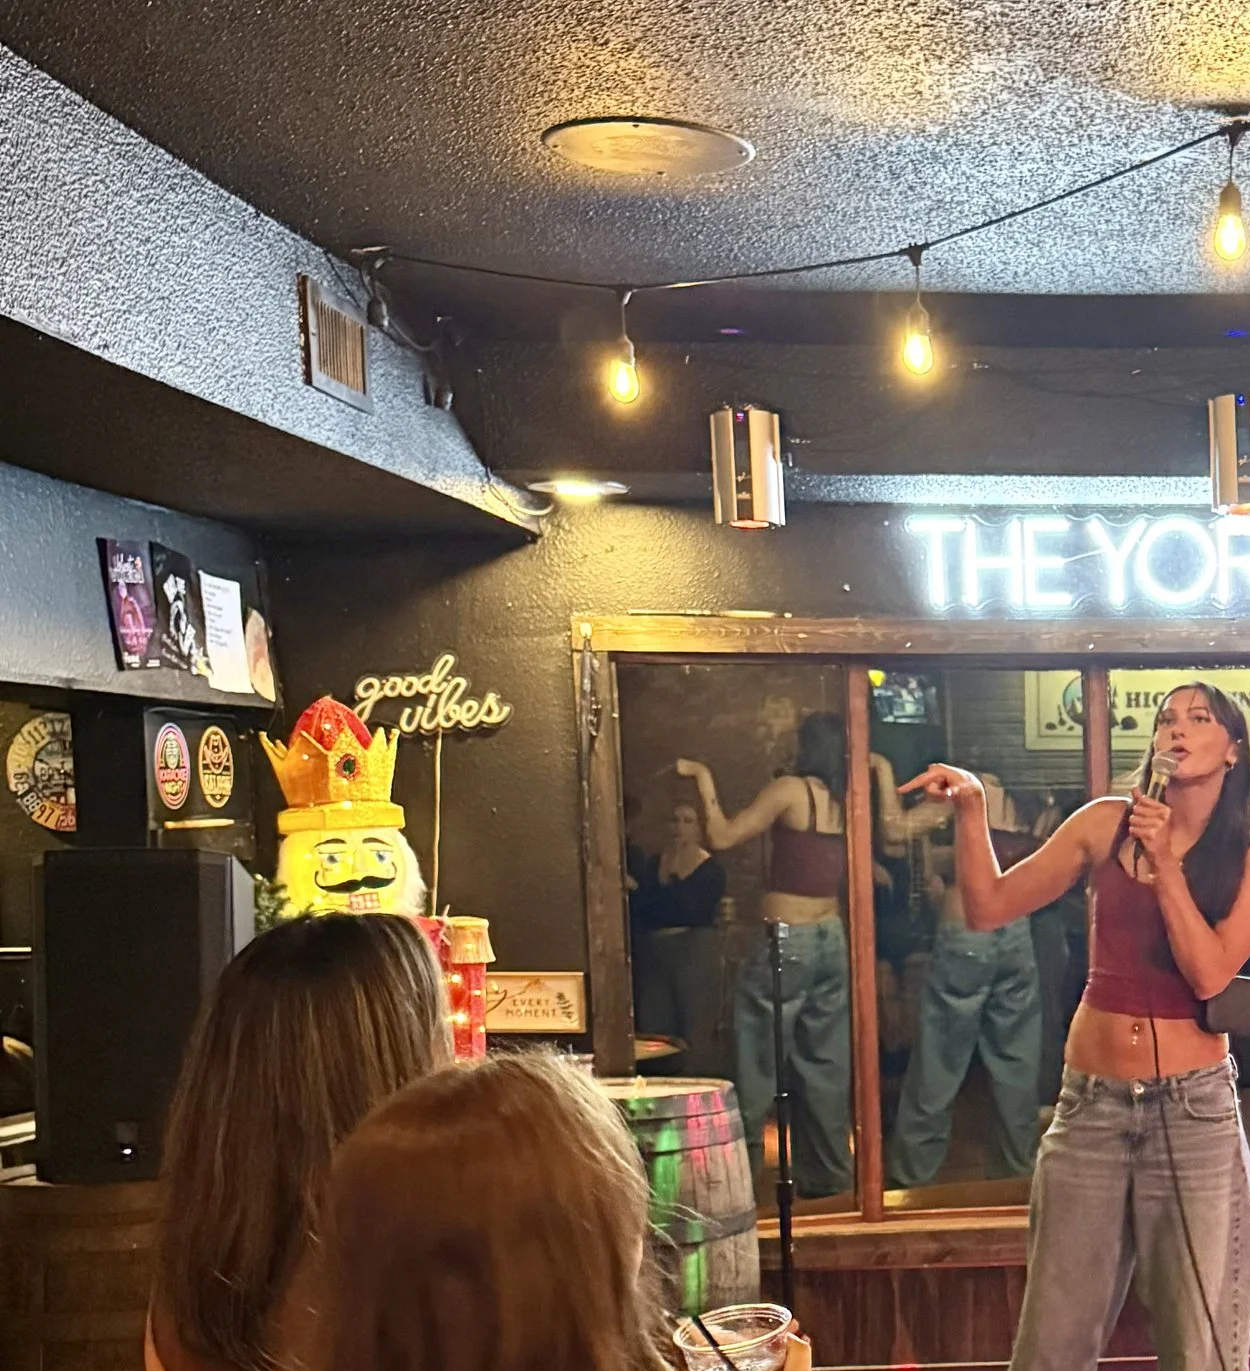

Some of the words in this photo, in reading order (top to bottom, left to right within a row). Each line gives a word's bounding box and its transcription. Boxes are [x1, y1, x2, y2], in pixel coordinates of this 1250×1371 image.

[907, 516, 1073, 609] THE
[353, 654, 456, 723] good
[400, 677, 511, 733] vibes
[505, 1008, 557, 1018] MOMENT
